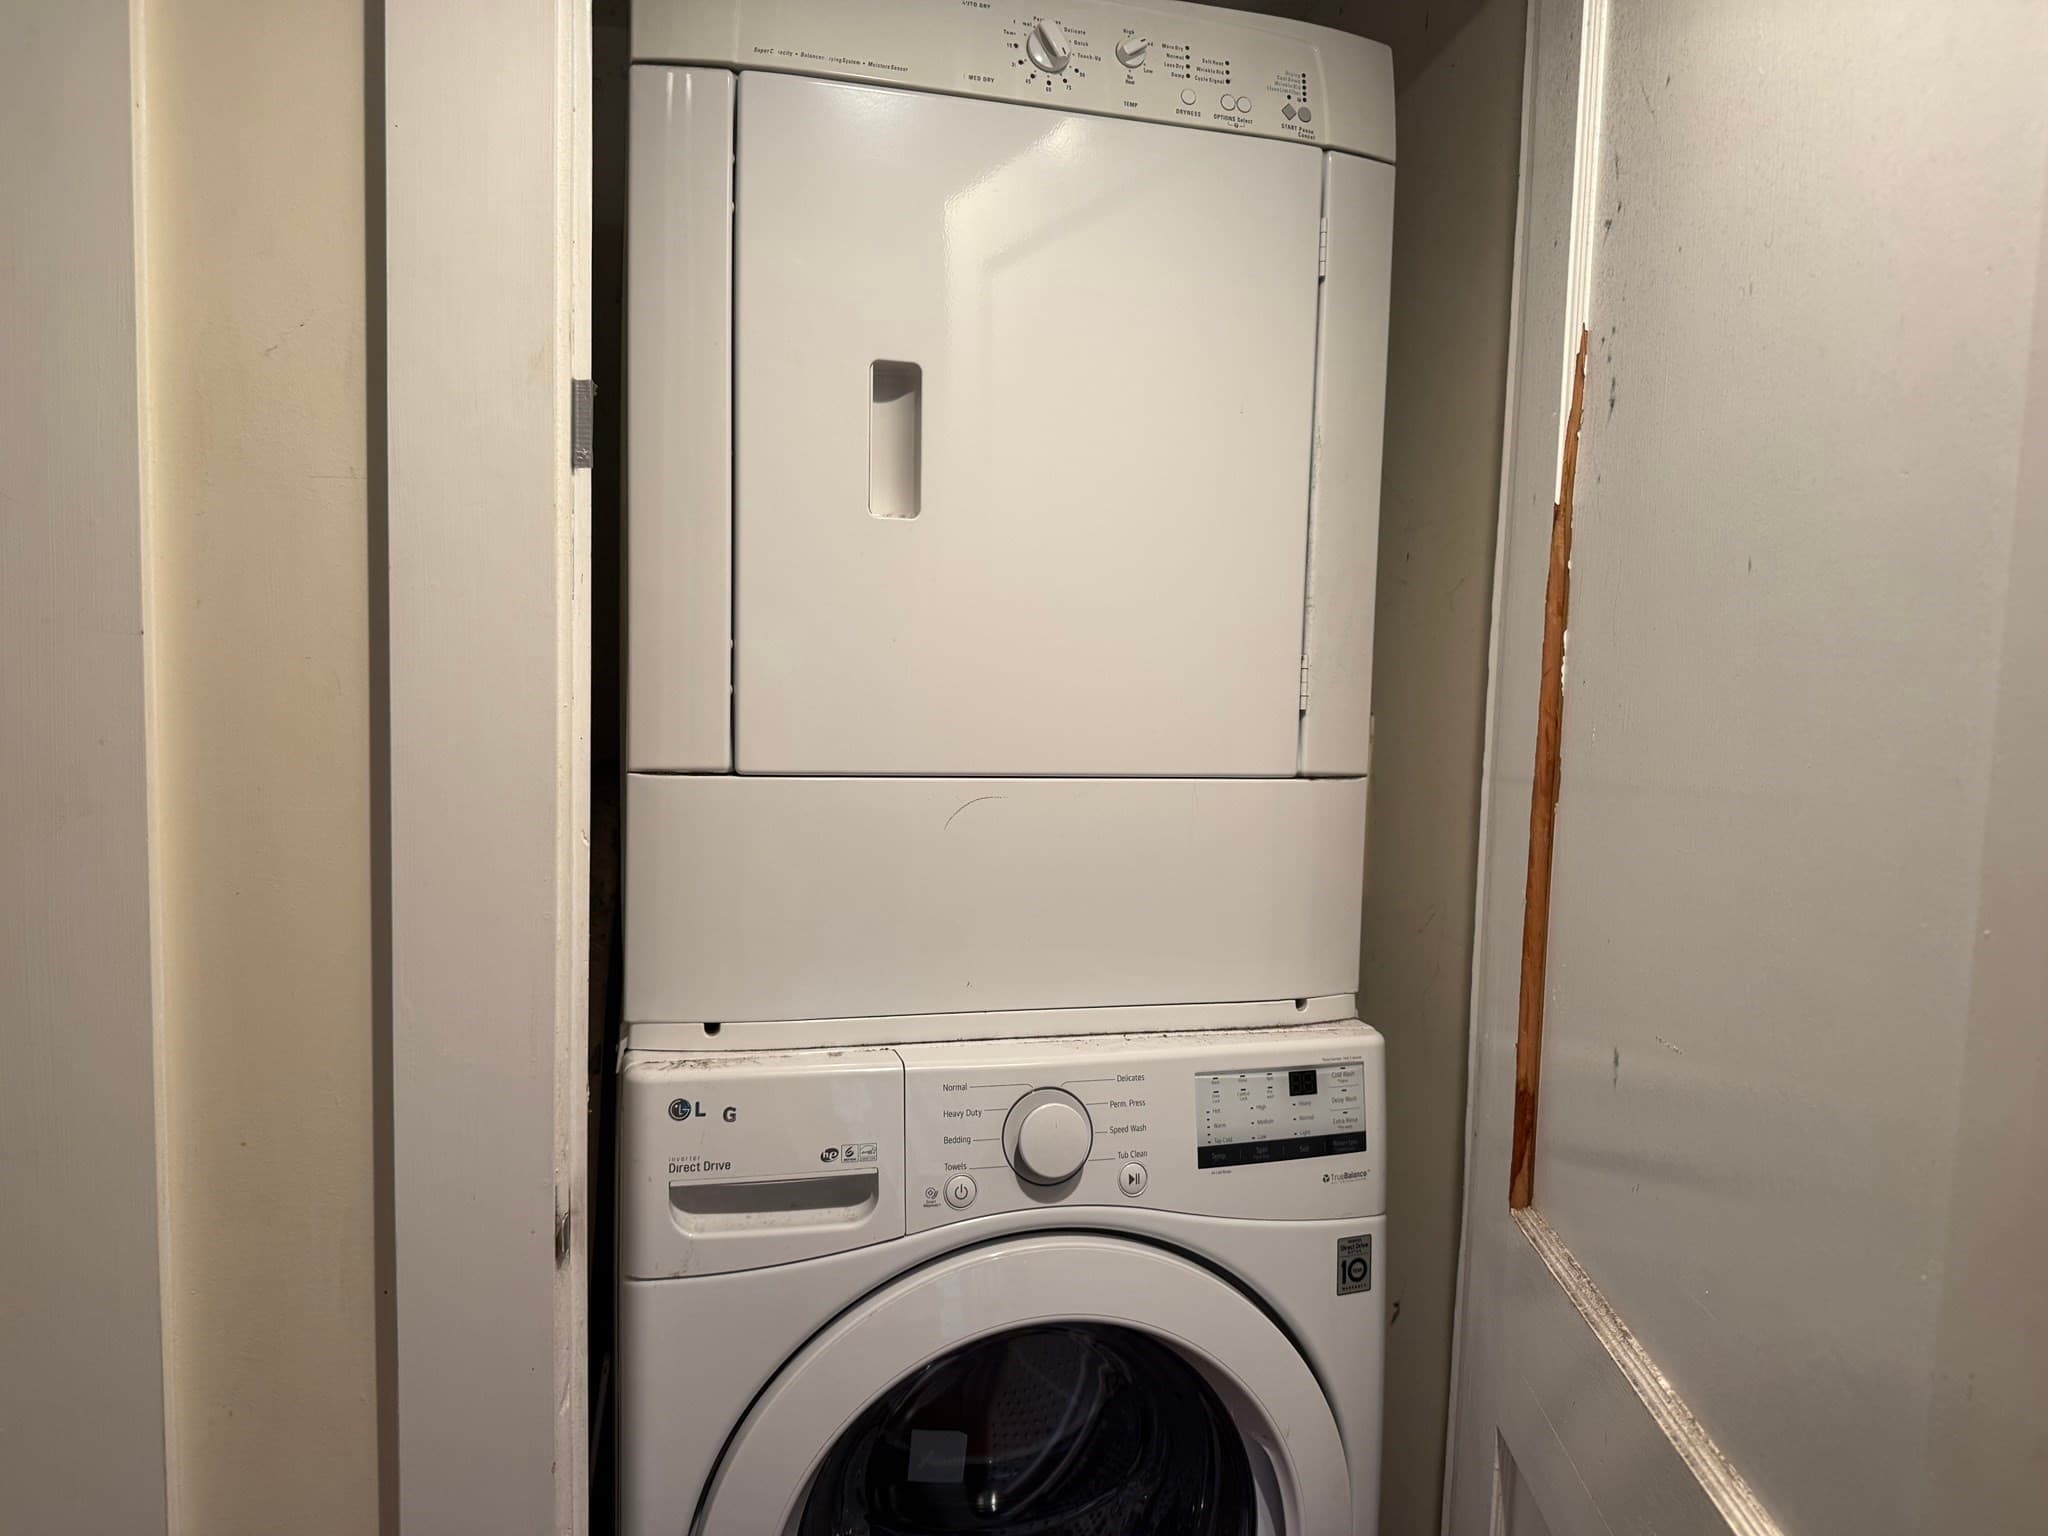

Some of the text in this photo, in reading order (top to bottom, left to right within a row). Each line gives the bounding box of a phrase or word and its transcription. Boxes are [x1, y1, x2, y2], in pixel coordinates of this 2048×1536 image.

[1123, 100, 1138, 108] TEMP
[1175, 108, 1201, 117] DRYNESS
[1213, 113, 1236, 122] OPTIONS
[1281, 123, 1297, 131] START
[1116, 1073, 1145, 1082] Delicates
[942, 1082, 968, 1092] Normal
[1129, 1098, 1146, 1107] Press
[943, 1107, 982, 1119] Heavy Duty
[1110, 1123, 1147, 1135] Speed Wash
[943, 1135, 972, 1145] Bedding
[1118, 1149, 1148, 1160] Tub Clean
[668, 1160, 731, 1174] Direct Drive
[944, 1161, 968, 1171] Towels
[1341, 1257, 1368, 1285] 10
